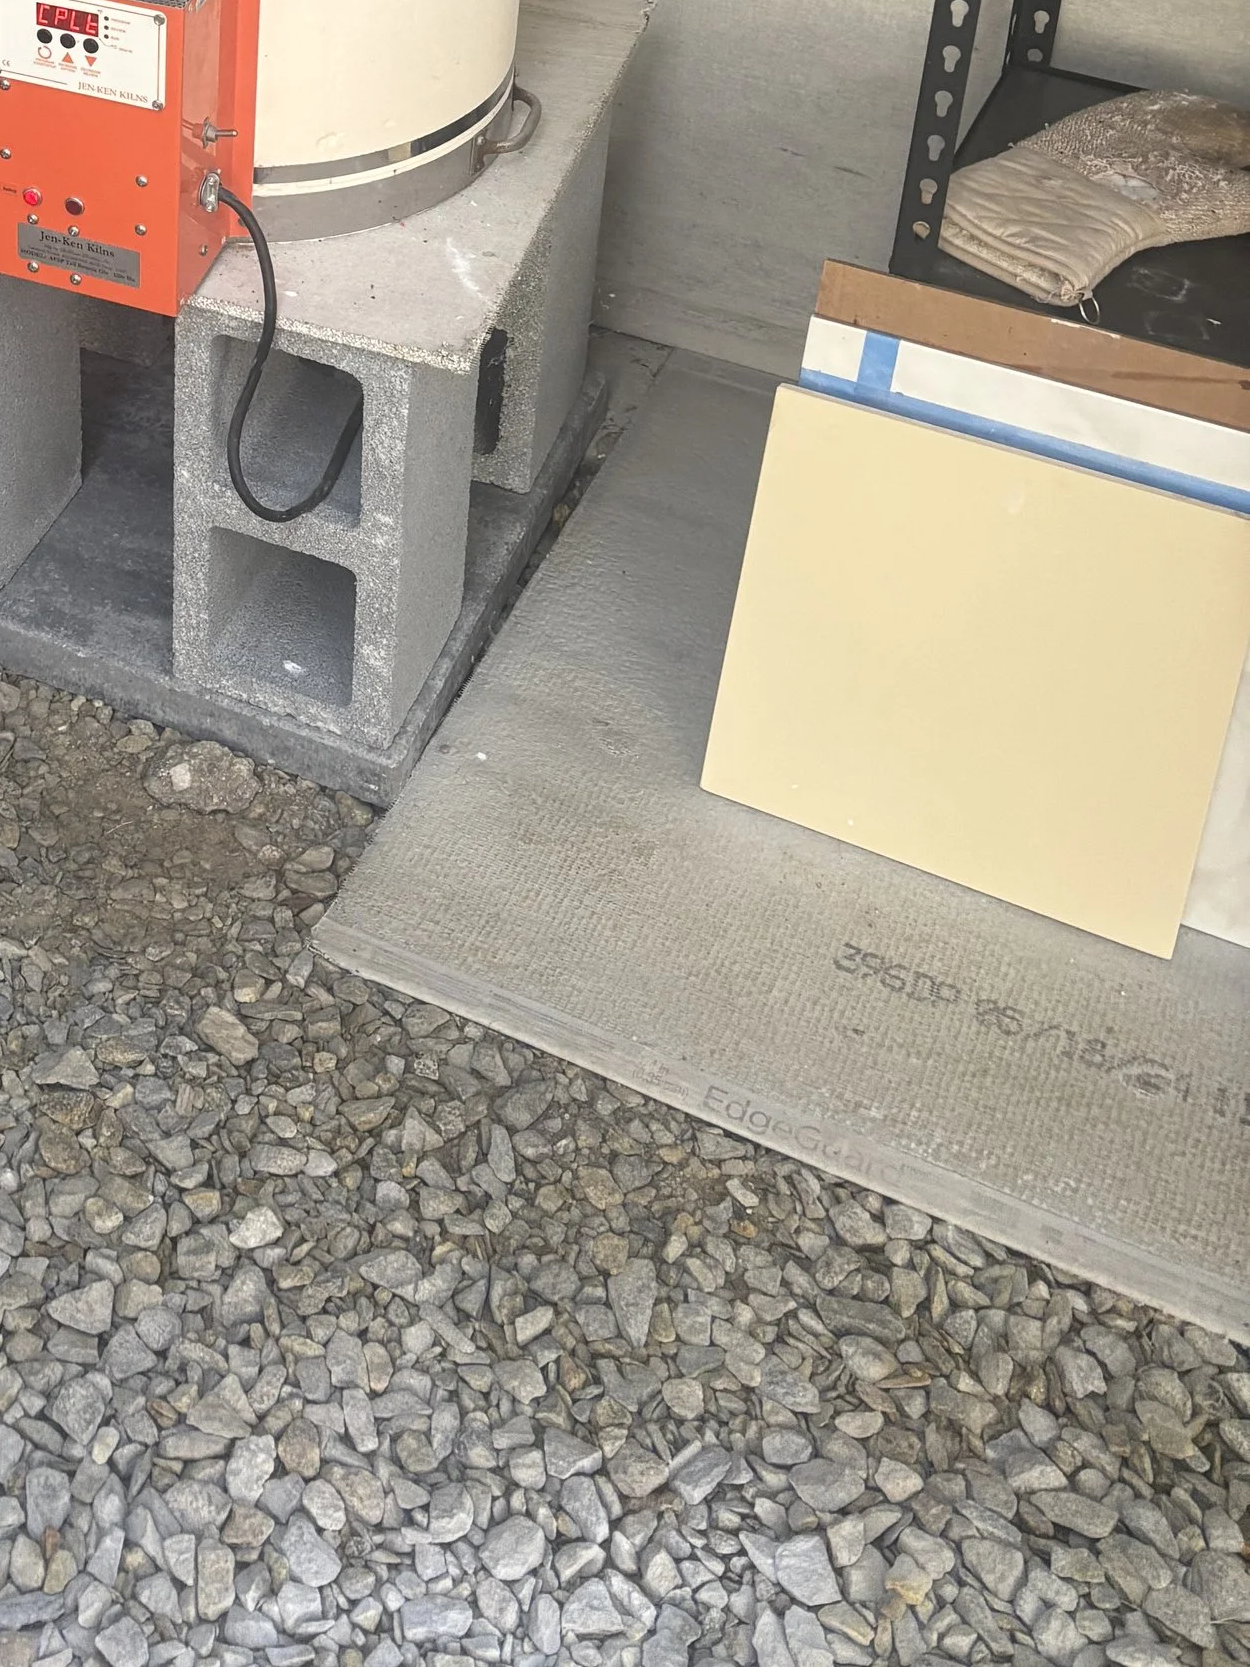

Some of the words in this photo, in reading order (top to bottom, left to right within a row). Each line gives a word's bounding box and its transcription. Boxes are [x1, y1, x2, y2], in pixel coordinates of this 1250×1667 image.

[78, 81, 117, 98] JEN-KEN
[119, 90, 148, 103] KILNS
[39, 231, 83, 250] Jen-Ken
[87, 242, 115, 258] Kilns
